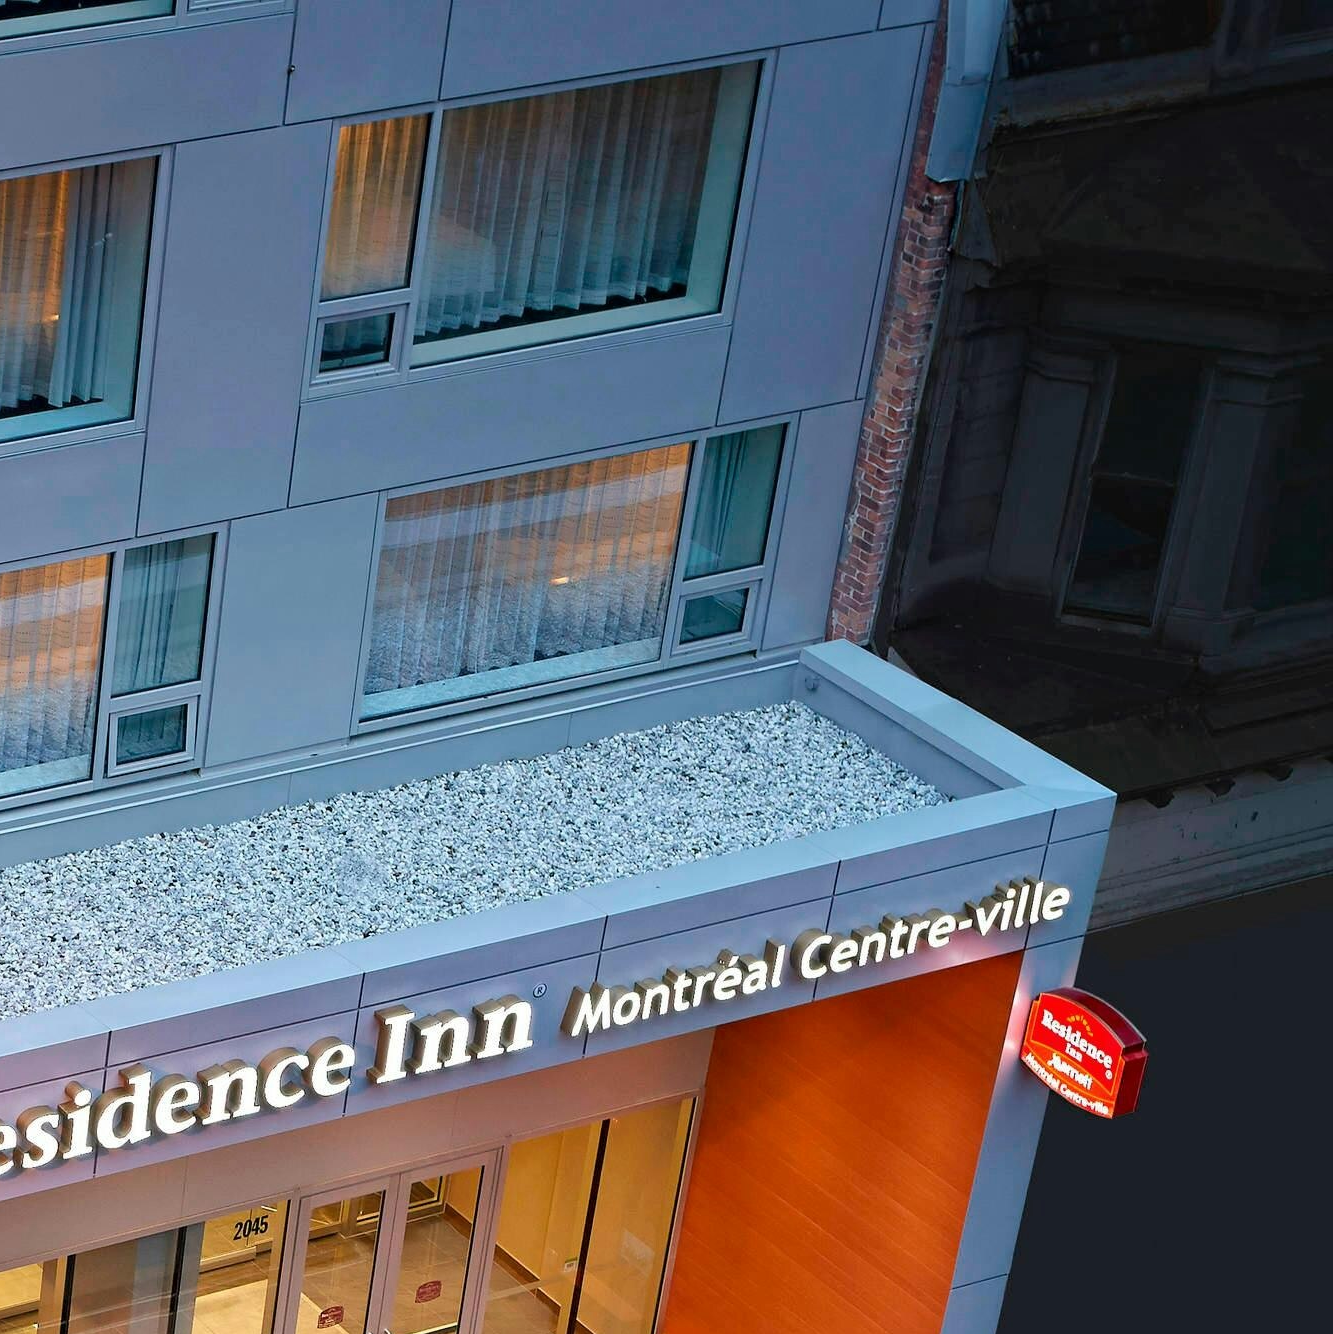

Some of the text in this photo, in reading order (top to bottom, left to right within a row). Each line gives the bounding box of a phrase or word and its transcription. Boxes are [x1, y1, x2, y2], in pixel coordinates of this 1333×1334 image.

[565, 877, 1071, 1038] Montréal Centre-ville
[367, 995, 534, 1086] Inn
[1041, 1009, 1113, 1069] Residence
[1065, 1043, 1083, 1063] Inn
[233, 1215, 269, 1241] 2045
